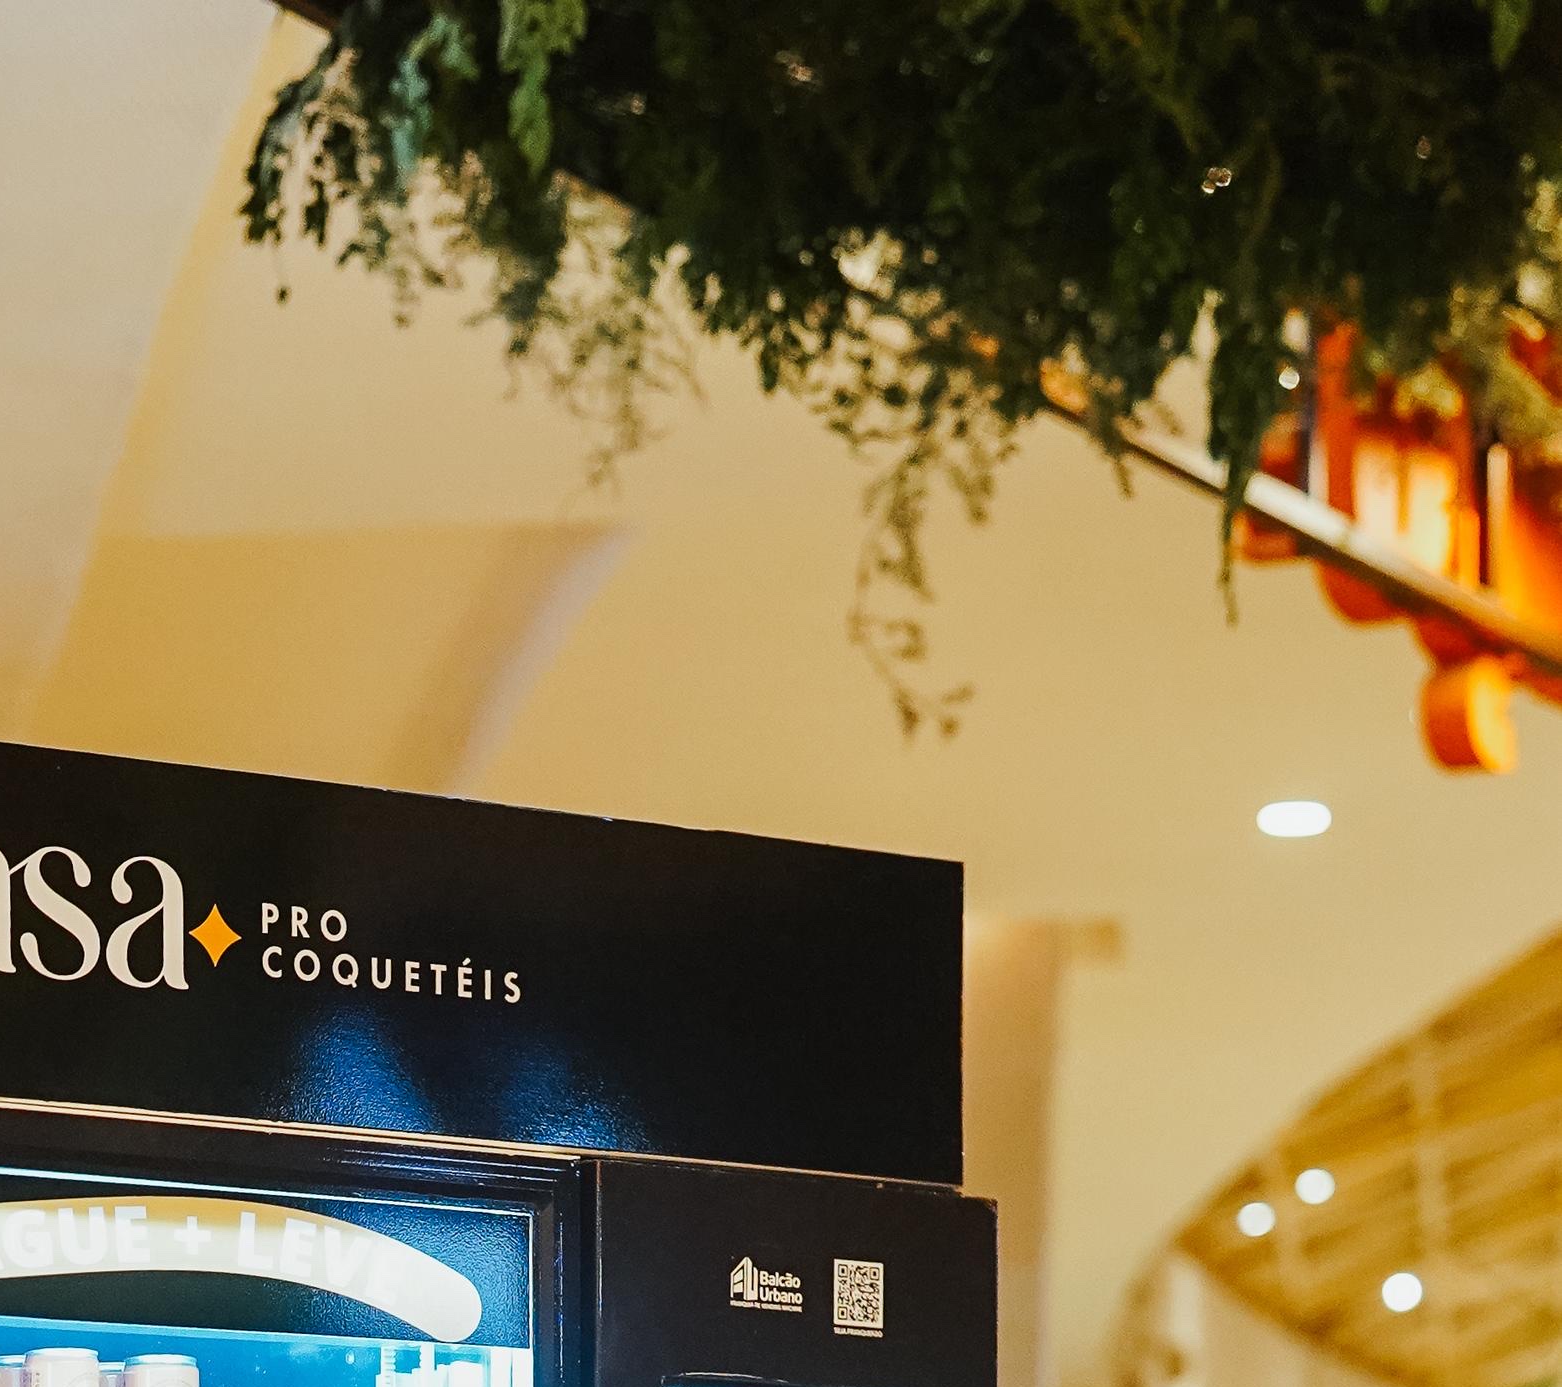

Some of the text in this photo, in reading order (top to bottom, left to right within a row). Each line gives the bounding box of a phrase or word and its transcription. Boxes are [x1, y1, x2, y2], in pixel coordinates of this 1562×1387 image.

[261, 902, 348, 942] PRO
[261, 946, 522, 1004] COQUETÉIS
[237, 1210, 402, 1305] LEVE
[760, 1270, 801, 1288] Balcão
[760, 1287, 803, 1304] Urbano
